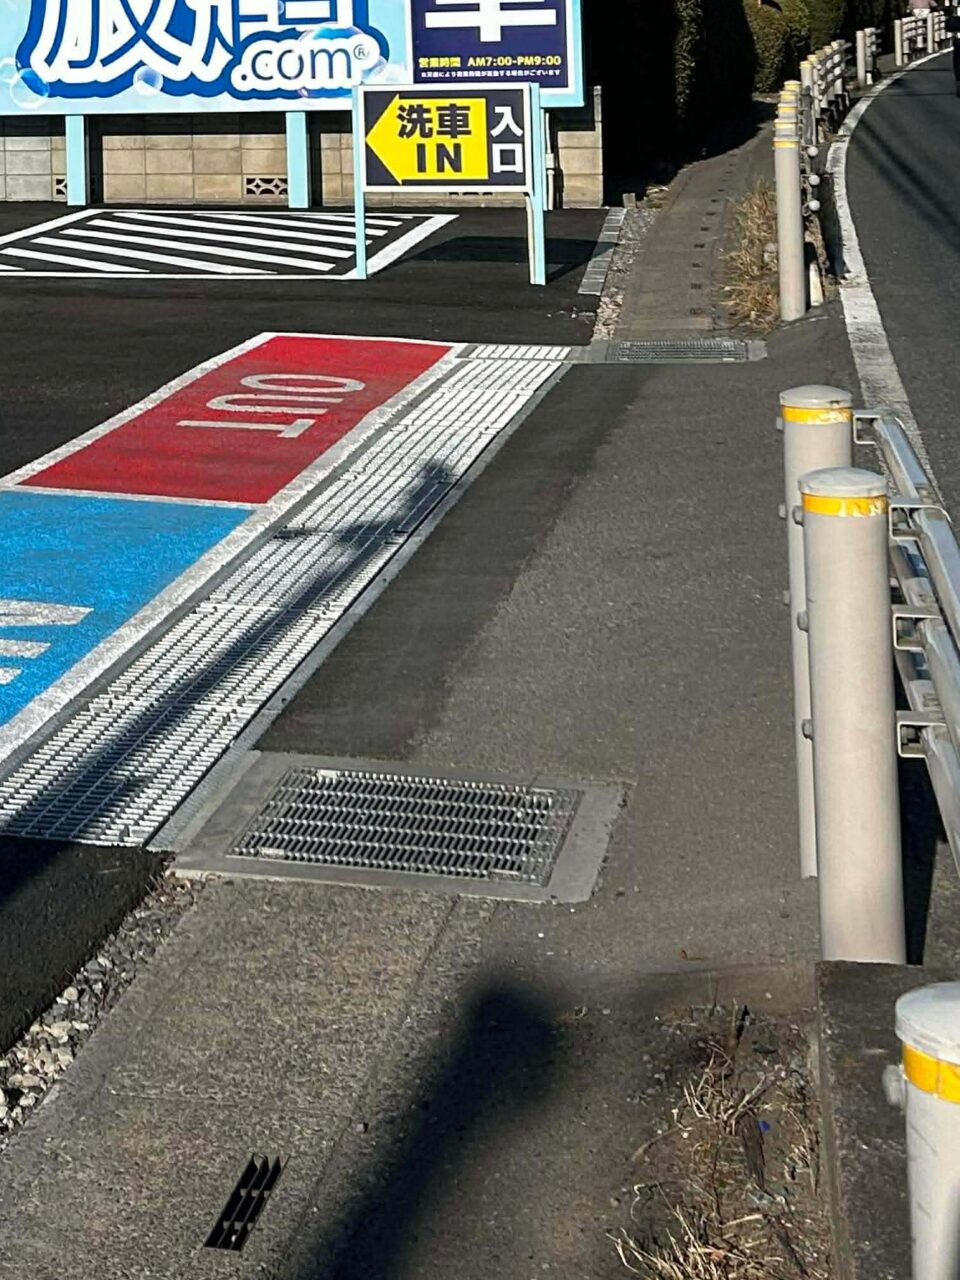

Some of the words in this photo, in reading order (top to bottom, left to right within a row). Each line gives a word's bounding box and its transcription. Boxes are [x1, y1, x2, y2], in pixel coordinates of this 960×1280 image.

[467, 55, 562, 67] AM7:00-PM9:00
[396, 103, 472, 139] 洗車
[416, 143, 463, 173] IN
[491, 106, 524, 174] 入口
[176, 373, 366, 438] OUT
